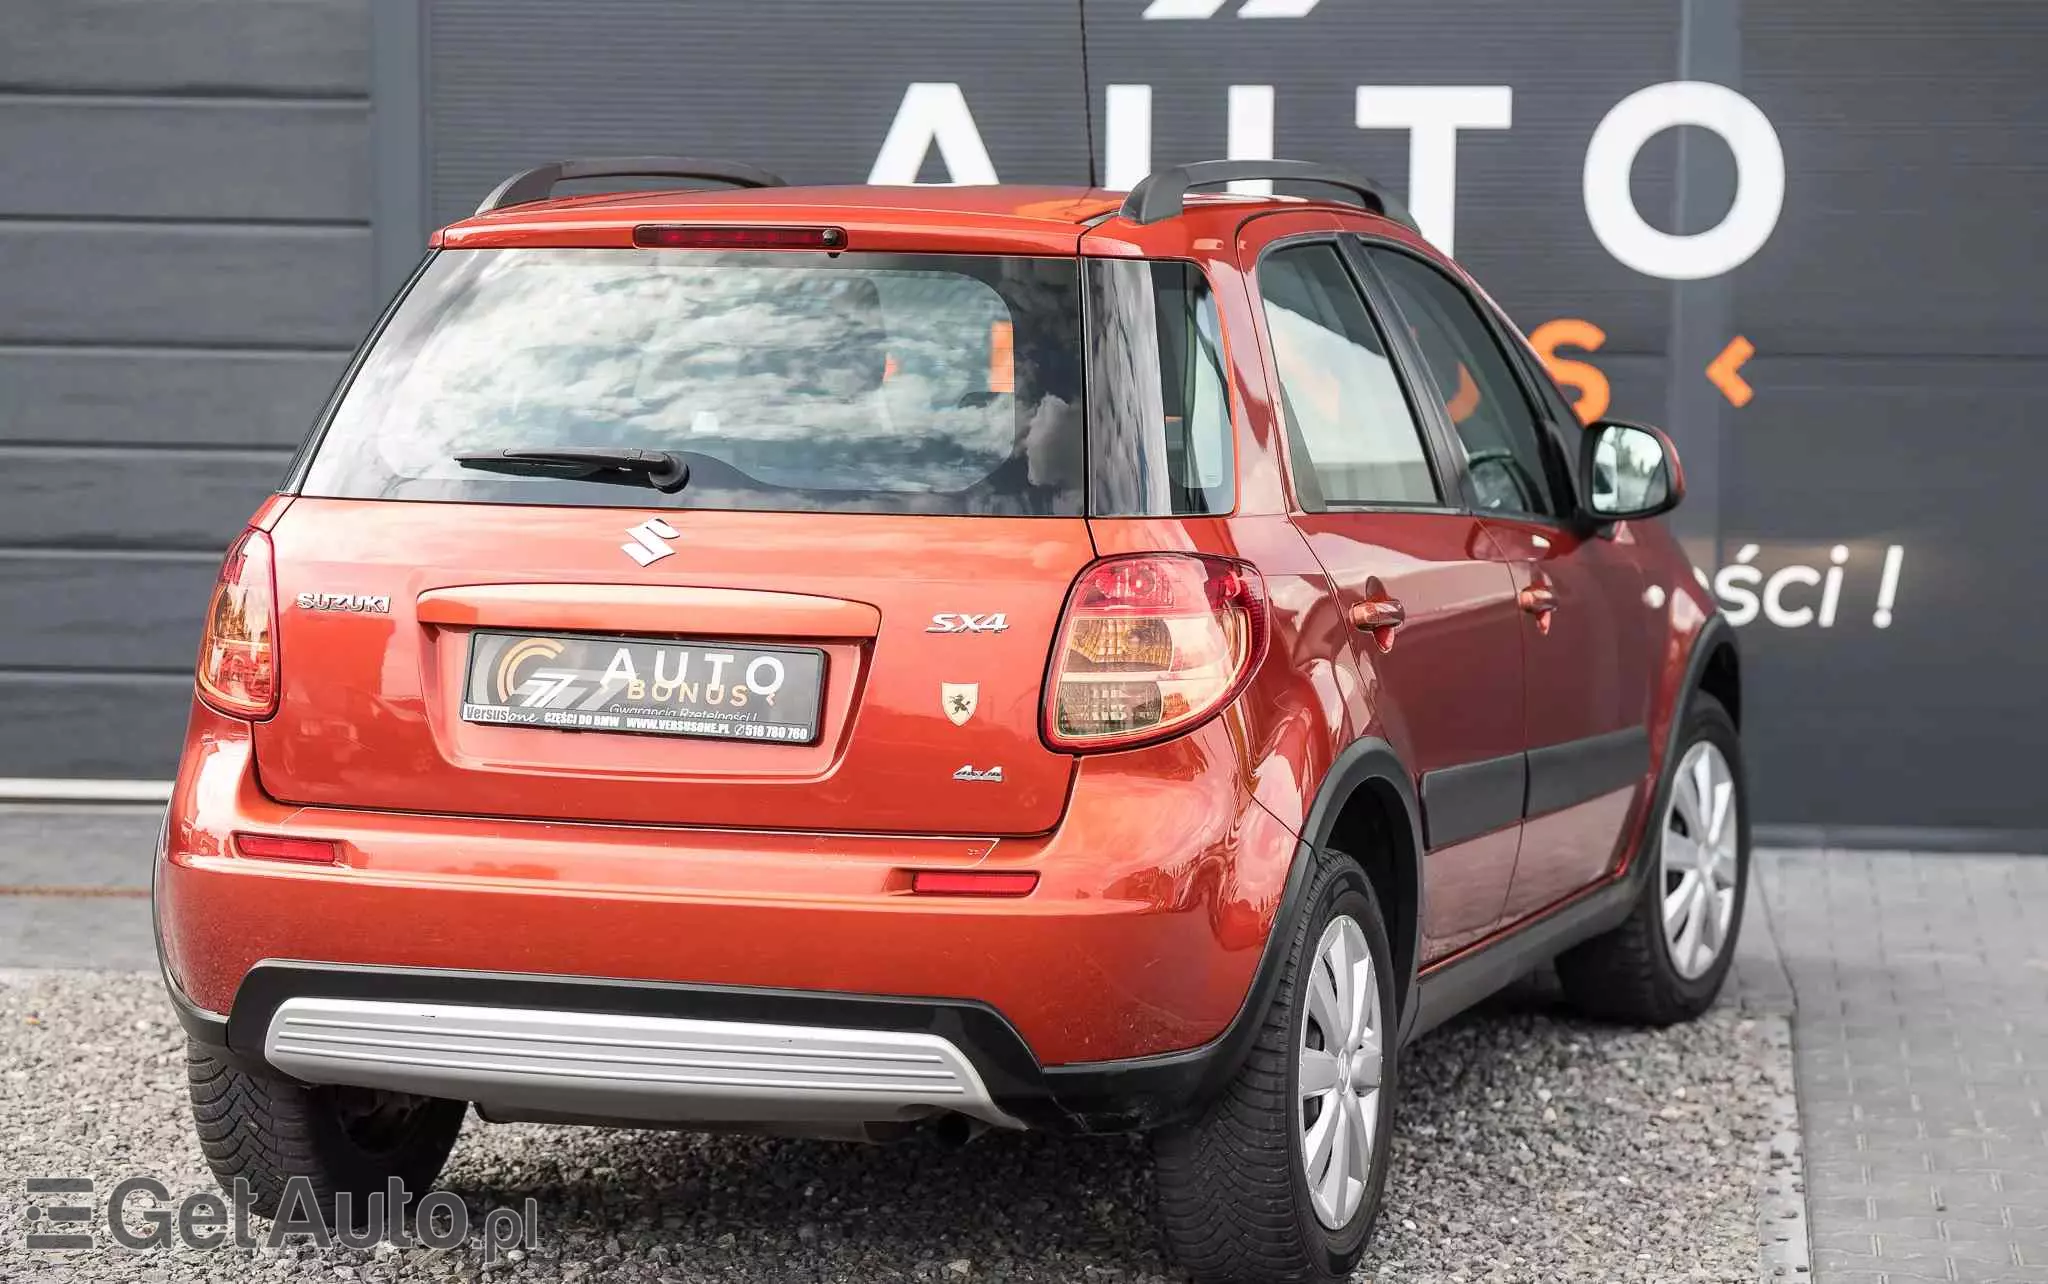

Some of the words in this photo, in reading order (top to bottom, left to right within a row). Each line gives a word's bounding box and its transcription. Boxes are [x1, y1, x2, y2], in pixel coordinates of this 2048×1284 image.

[297, 591, 391, 614] SUZUKI
[925, 613, 1010, 633] SX4
[600, 647, 785, 696] AUTO
[627, 679, 750, 707] BONUS
[578, 715, 593, 727] DO
[626, 717, 730, 735] WWW.VERSUSONE.PL
